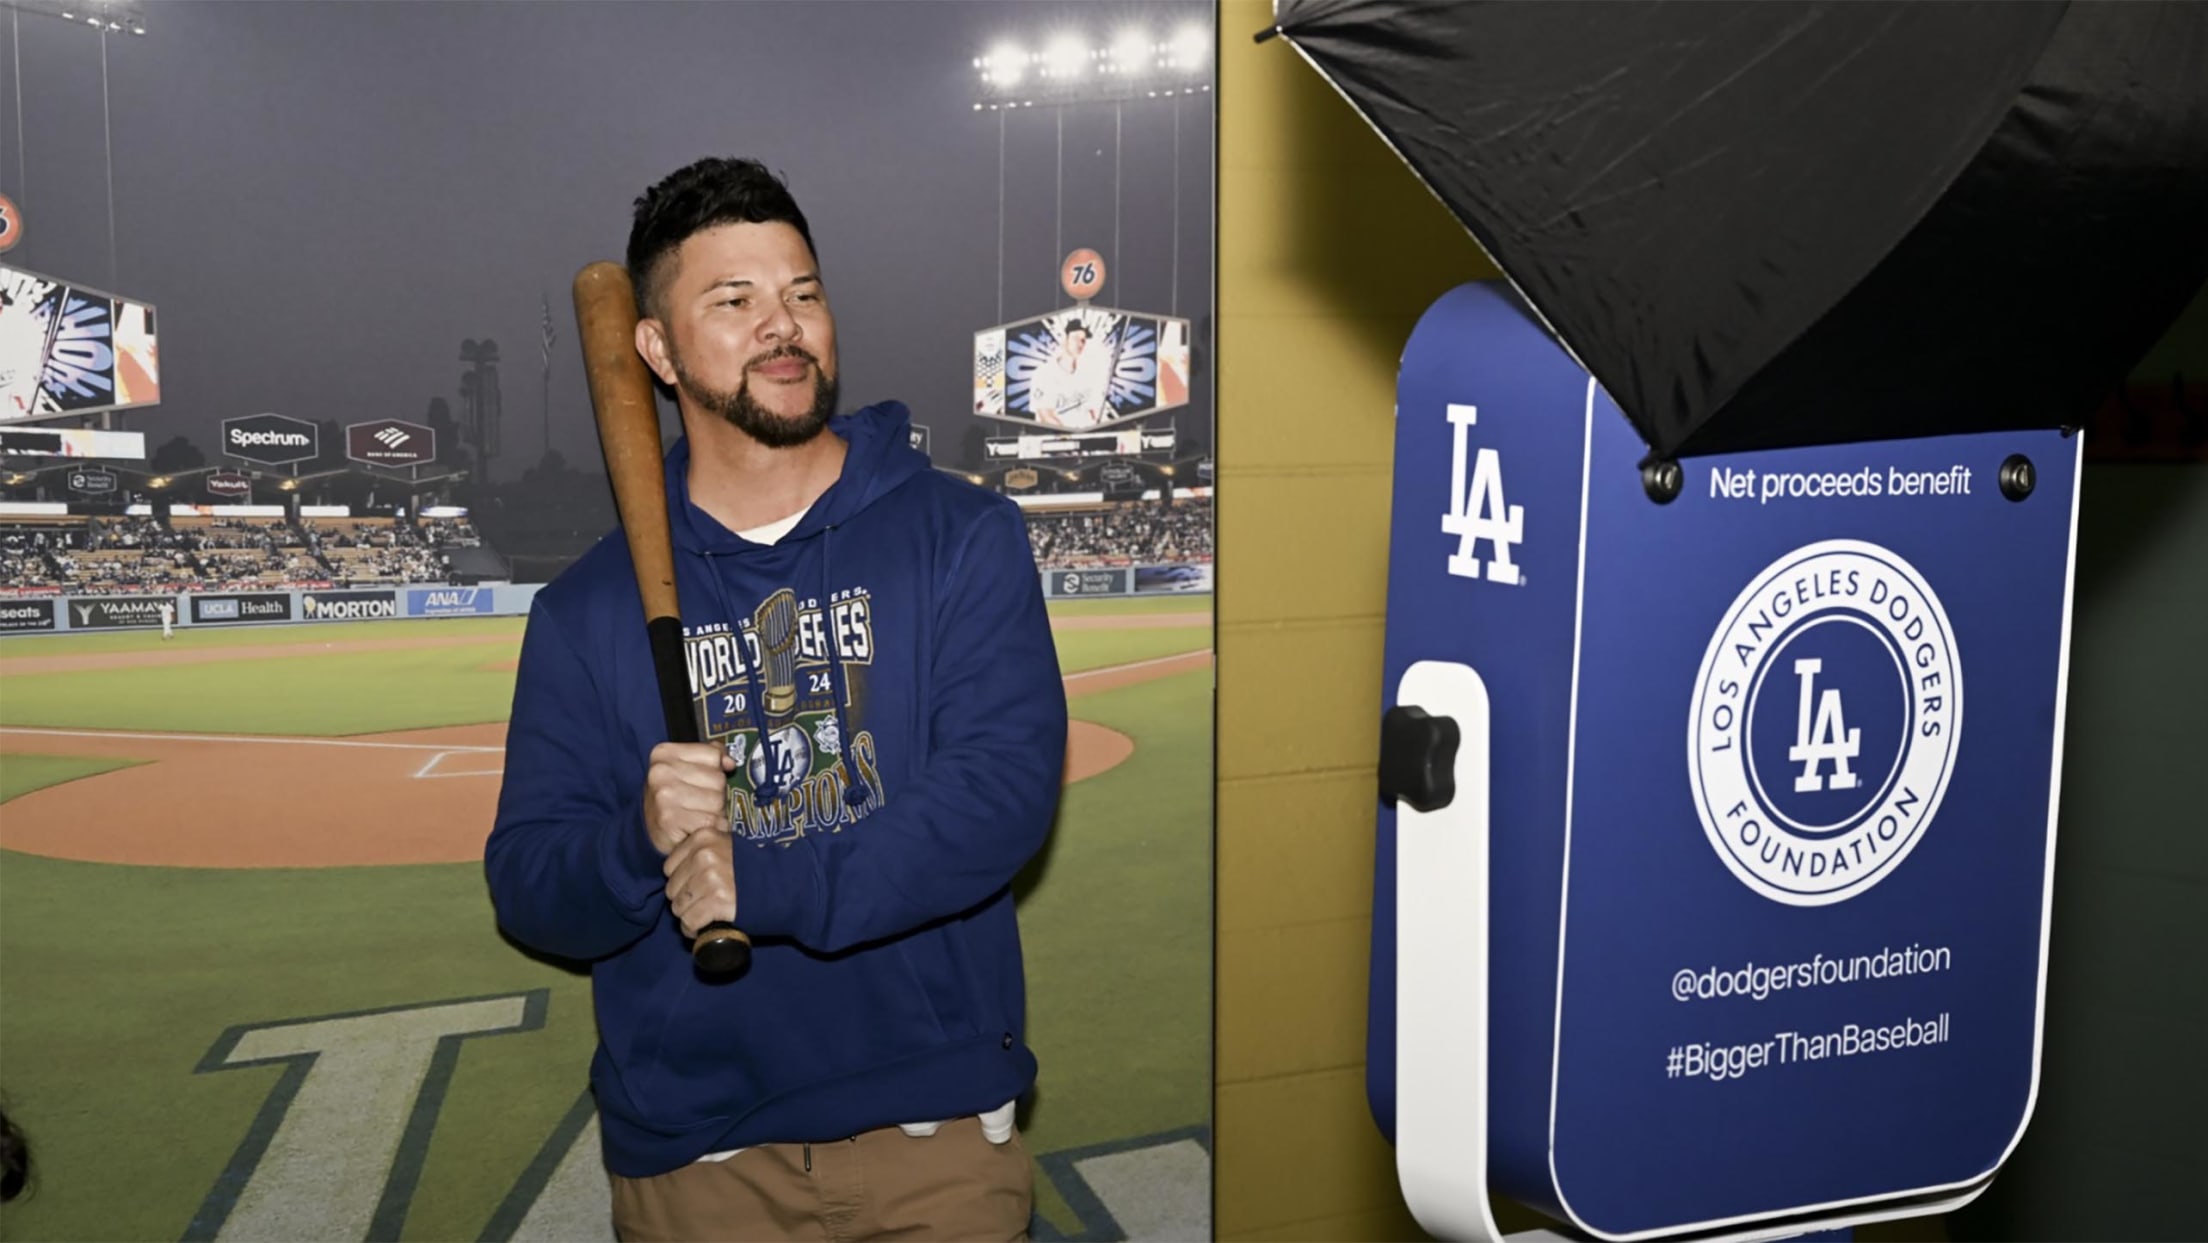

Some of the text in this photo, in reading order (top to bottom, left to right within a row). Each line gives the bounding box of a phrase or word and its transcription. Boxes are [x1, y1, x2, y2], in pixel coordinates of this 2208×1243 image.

[1072, 261, 1096, 285] 76
[231, 429, 304, 446] Spectrum
[210, 479, 249, 489] Yakult
[1442, 404, 1524, 585] LA
[1710, 465, 1972, 504] Net proceeds benefit
[1082, 572, 1114, 584] Security
[0, 606, 40, 619] seats
[203, 600, 284, 615] UCLA Health
[317, 600, 396, 618] MORTON
[425, 591, 459, 607] ANA
[795, 601, 870, 657] ERIES
[1712, 570, 1942, 752] LOS ANGELES DODGERS
[724, 672, 832, 713] 20 24
[1789, 658, 1861, 792] LA
[731, 732, 884, 839] AMPIONS
[1726, 787, 1919, 877] FOUNDATION
[1672, 943, 1951, 1001] @dodgersfoundation
[1666, 1013, 1950, 1080] #BiggerThanBaseball
